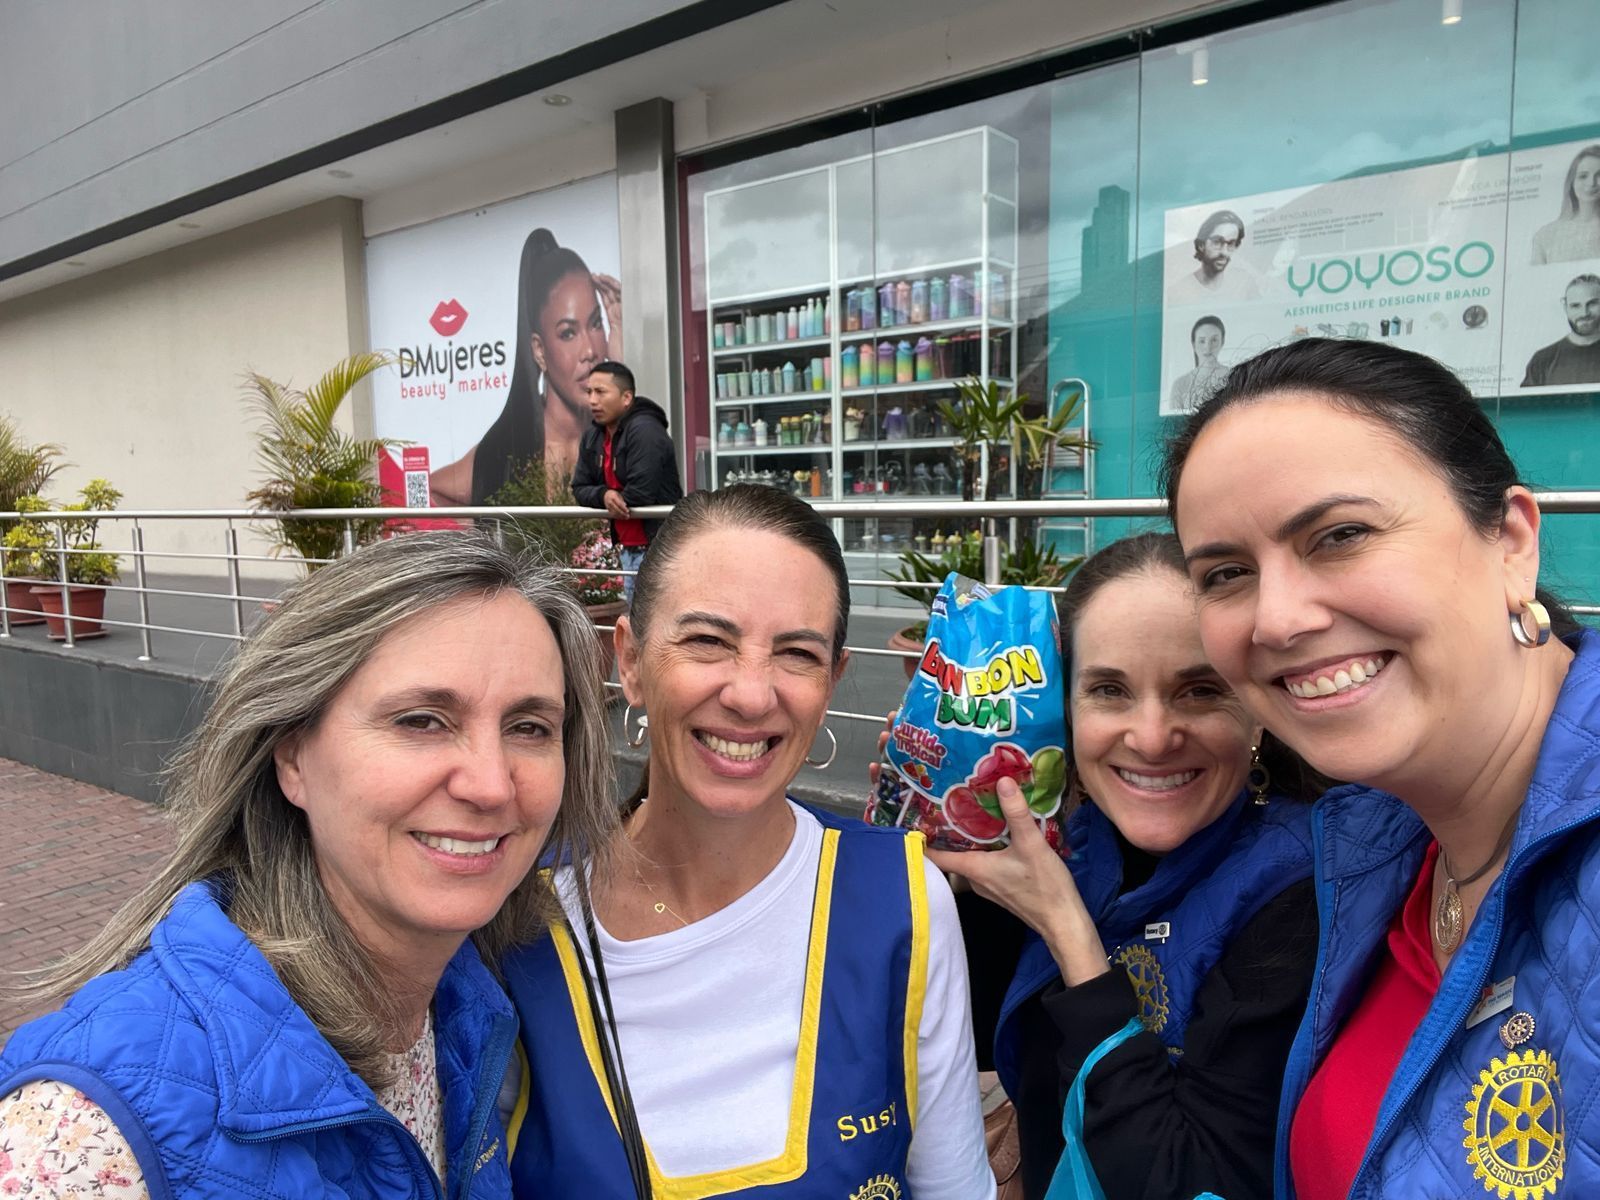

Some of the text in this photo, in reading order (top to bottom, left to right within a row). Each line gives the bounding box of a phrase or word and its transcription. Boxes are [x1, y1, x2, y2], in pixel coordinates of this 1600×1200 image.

[1287, 241, 1495, 298] YOYOSO
[1284, 286, 1491, 318] AESTHETICS LIFE DESIGNER BRAND
[399, 340, 507, 384] DMujeres
[400, 371, 509, 401] beauty market
[937, 693, 1012, 732] BUM
